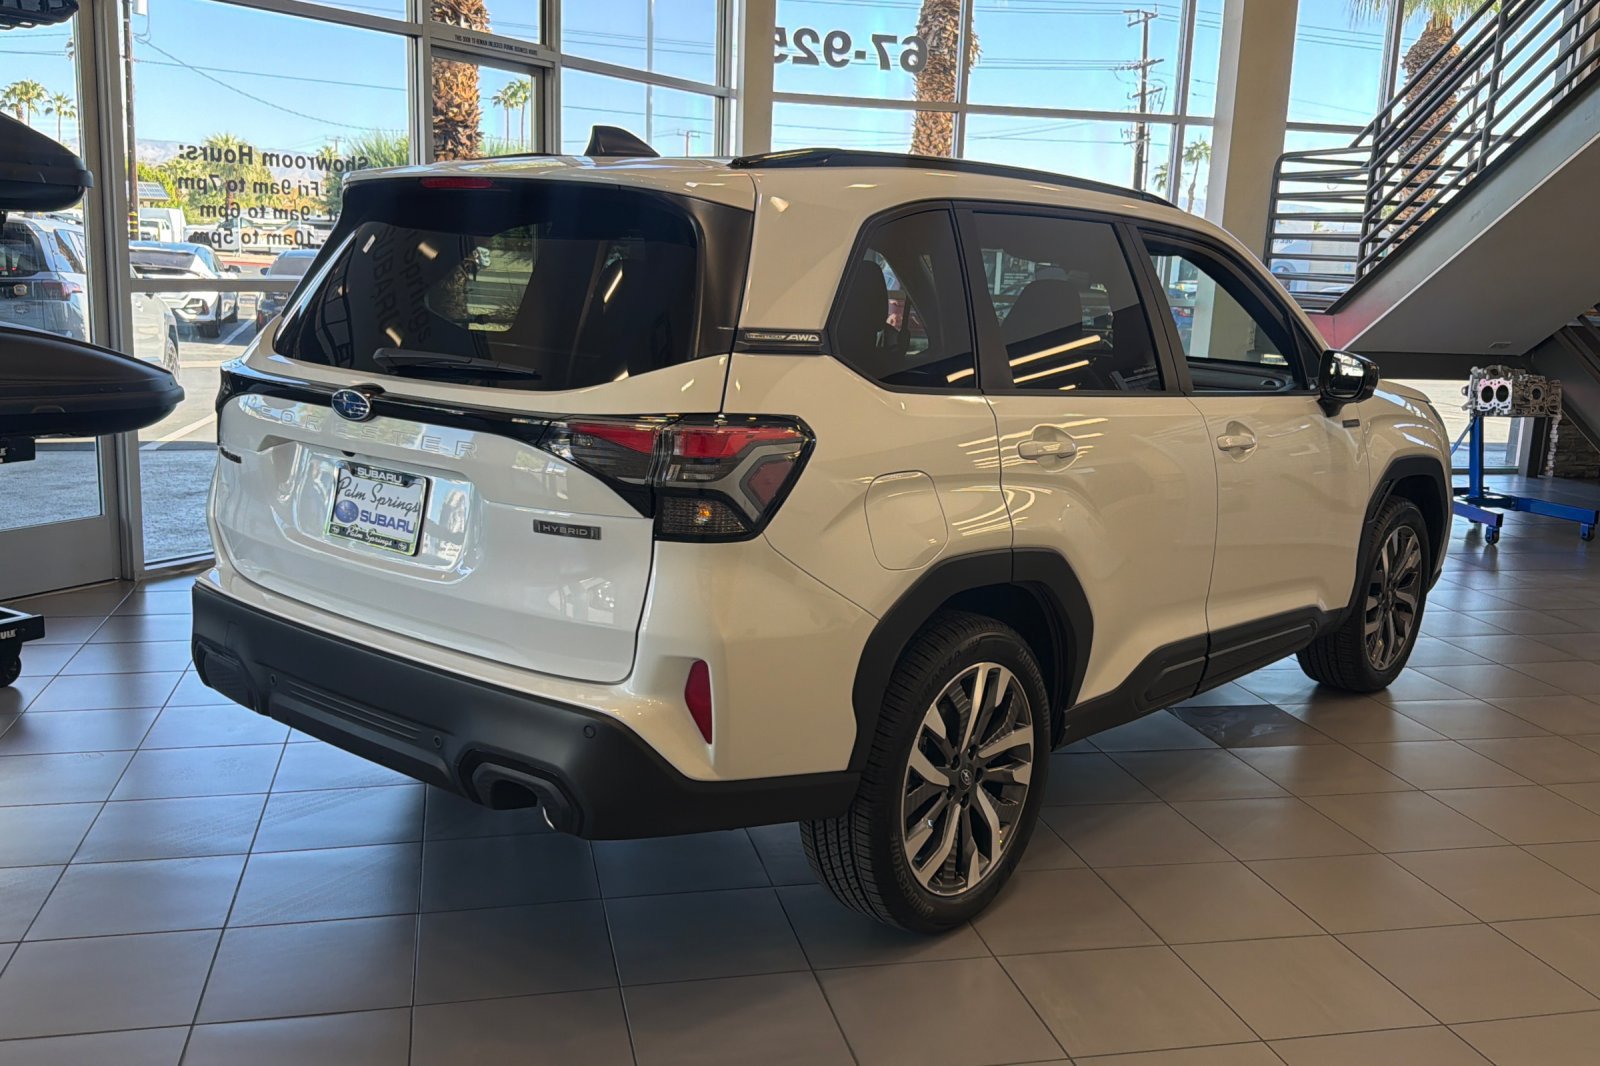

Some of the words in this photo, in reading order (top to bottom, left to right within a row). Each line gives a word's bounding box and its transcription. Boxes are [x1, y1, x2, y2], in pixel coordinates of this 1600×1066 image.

[785, 334, 820, 342] AWD
[260, 405, 478, 460] FORESTER
[357, 467, 403, 484] SUBARU
[337, 476, 366, 501] Palm
[369, 483, 420, 517] Springs
[360, 509, 416, 534] SUBARU
[542, 524, 588, 536] HYBRID
[345, 526, 363, 539] Palm
[365, 528, 393, 546] Springs
